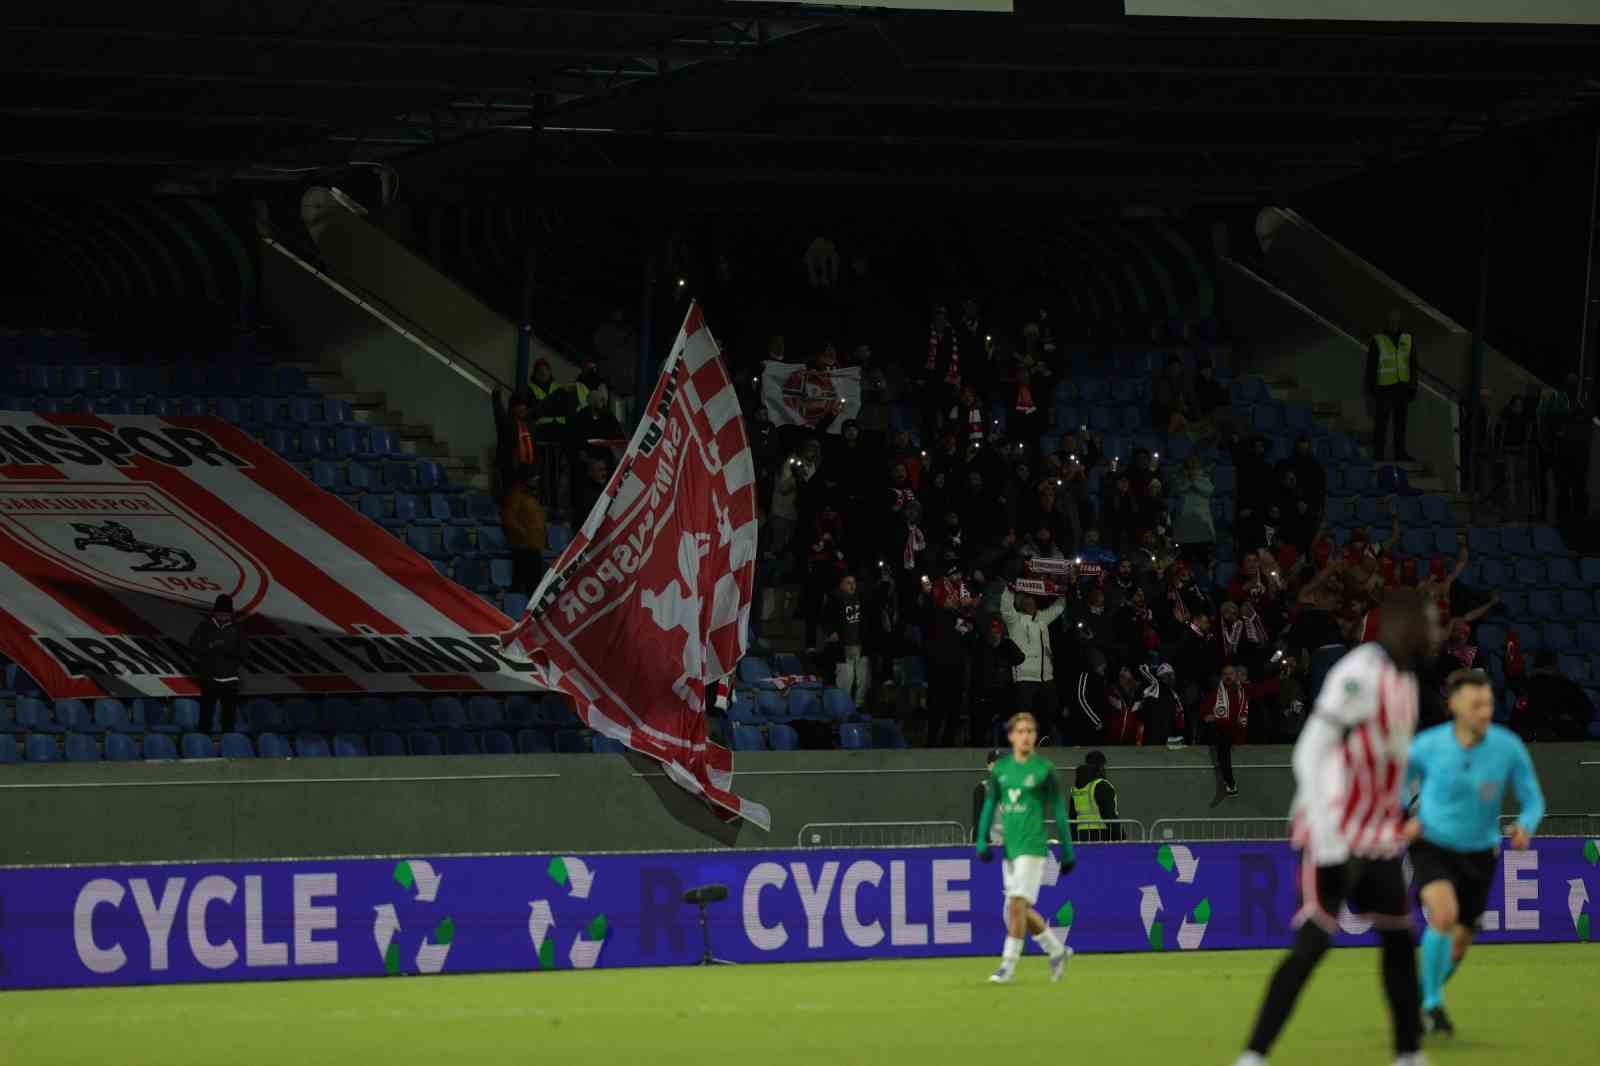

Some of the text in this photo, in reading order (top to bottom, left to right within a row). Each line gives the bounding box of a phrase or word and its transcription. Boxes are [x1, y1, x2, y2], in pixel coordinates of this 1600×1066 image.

[0, 425, 251, 466] NSPOR
[152, 576, 222, 591] 1965
[73, 872, 339, 974] CYCLE
[742, 859, 972, 950] CYCLE
